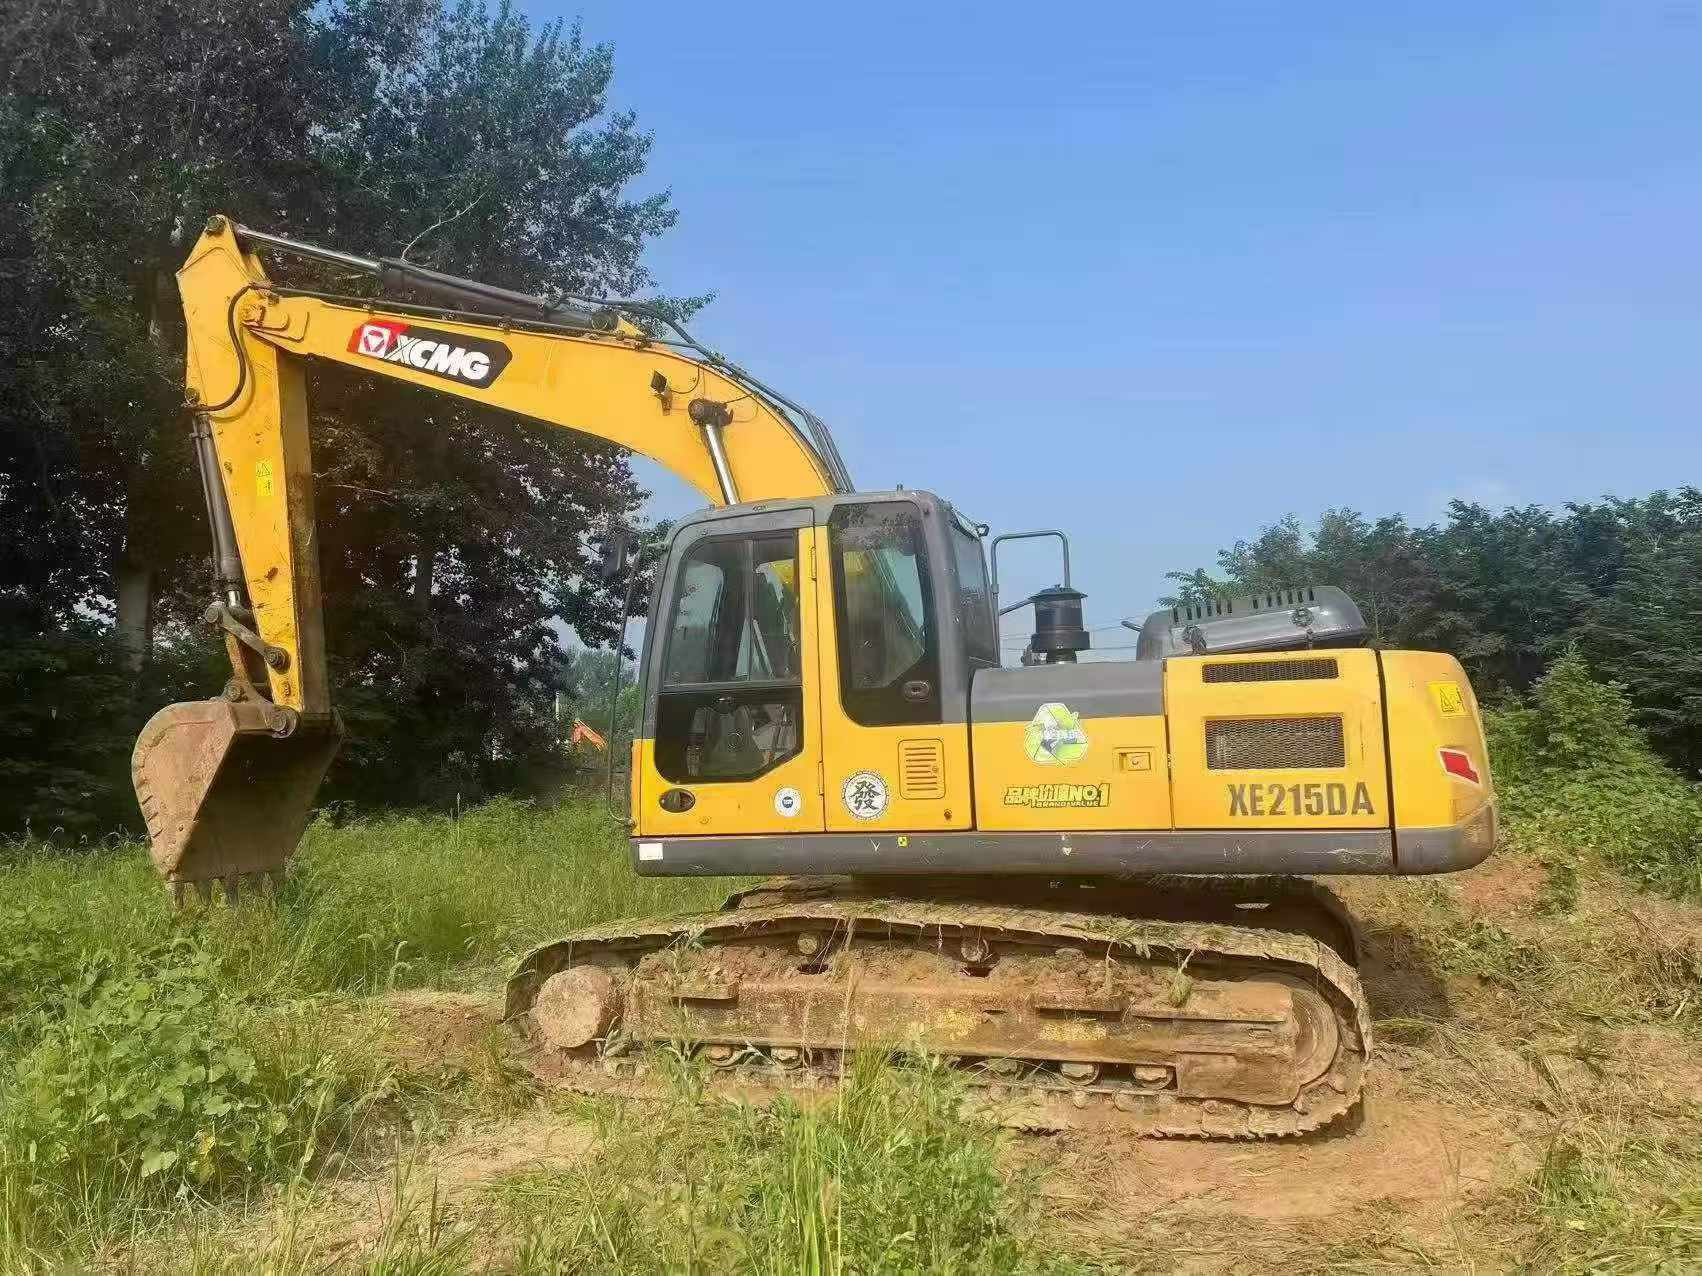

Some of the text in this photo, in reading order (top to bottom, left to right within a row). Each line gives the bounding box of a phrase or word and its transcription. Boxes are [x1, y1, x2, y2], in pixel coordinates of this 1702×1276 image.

[384, 335, 491, 380] XCMG
[850, 780, 882, 811] 發
[1228, 782, 1376, 816] XE215DA
